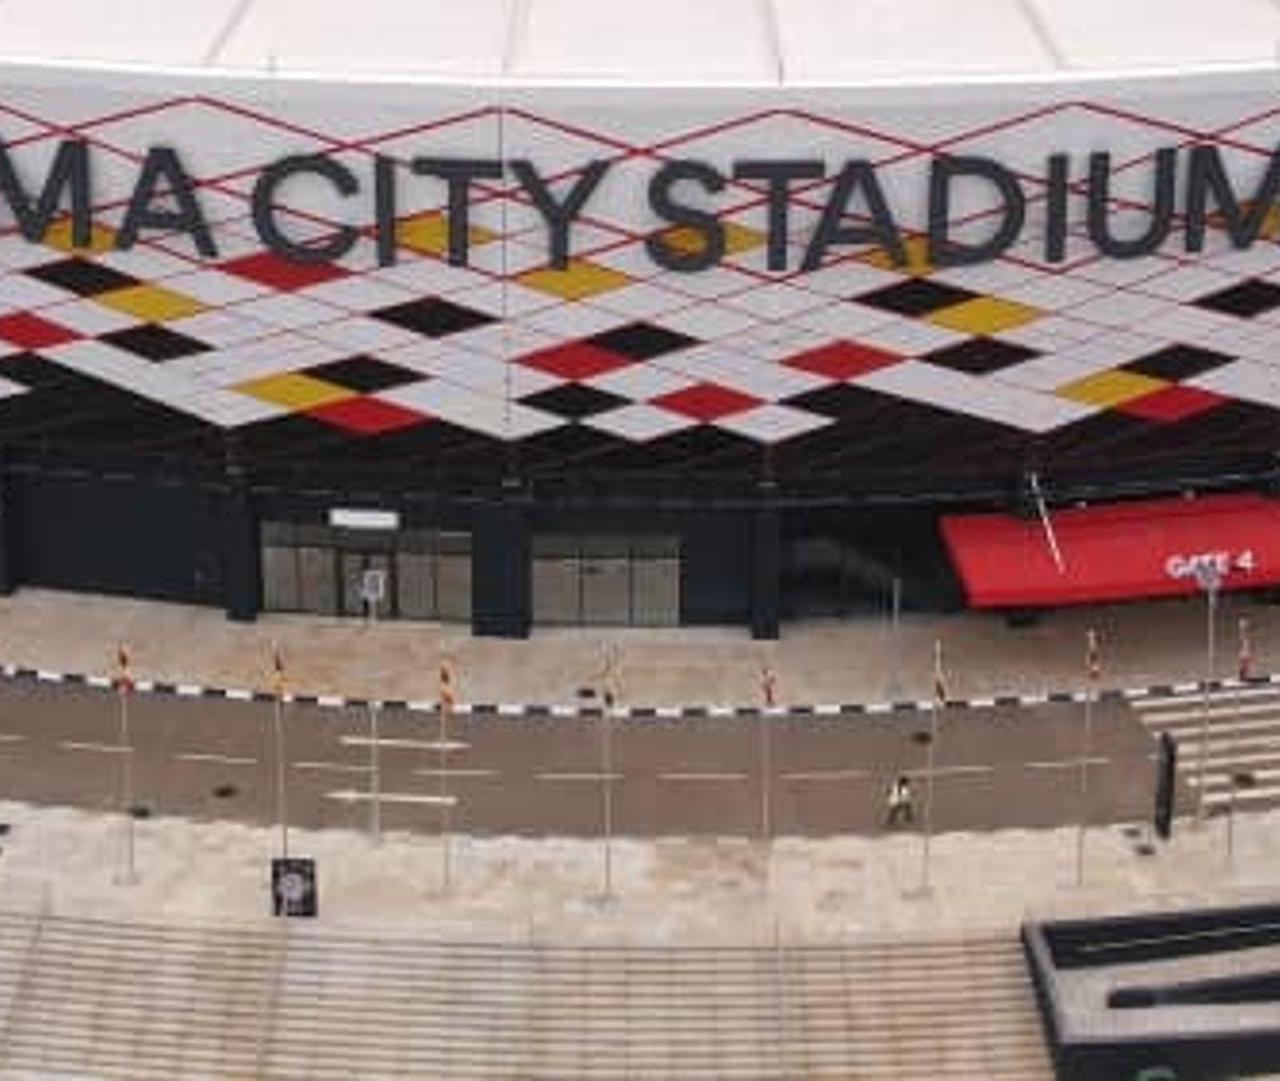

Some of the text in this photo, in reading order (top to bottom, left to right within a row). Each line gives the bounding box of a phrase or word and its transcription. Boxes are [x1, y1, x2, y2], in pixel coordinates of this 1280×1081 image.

[251, 152, 611, 272] CITY
[1165, 549, 1255, 580] GATE 4
